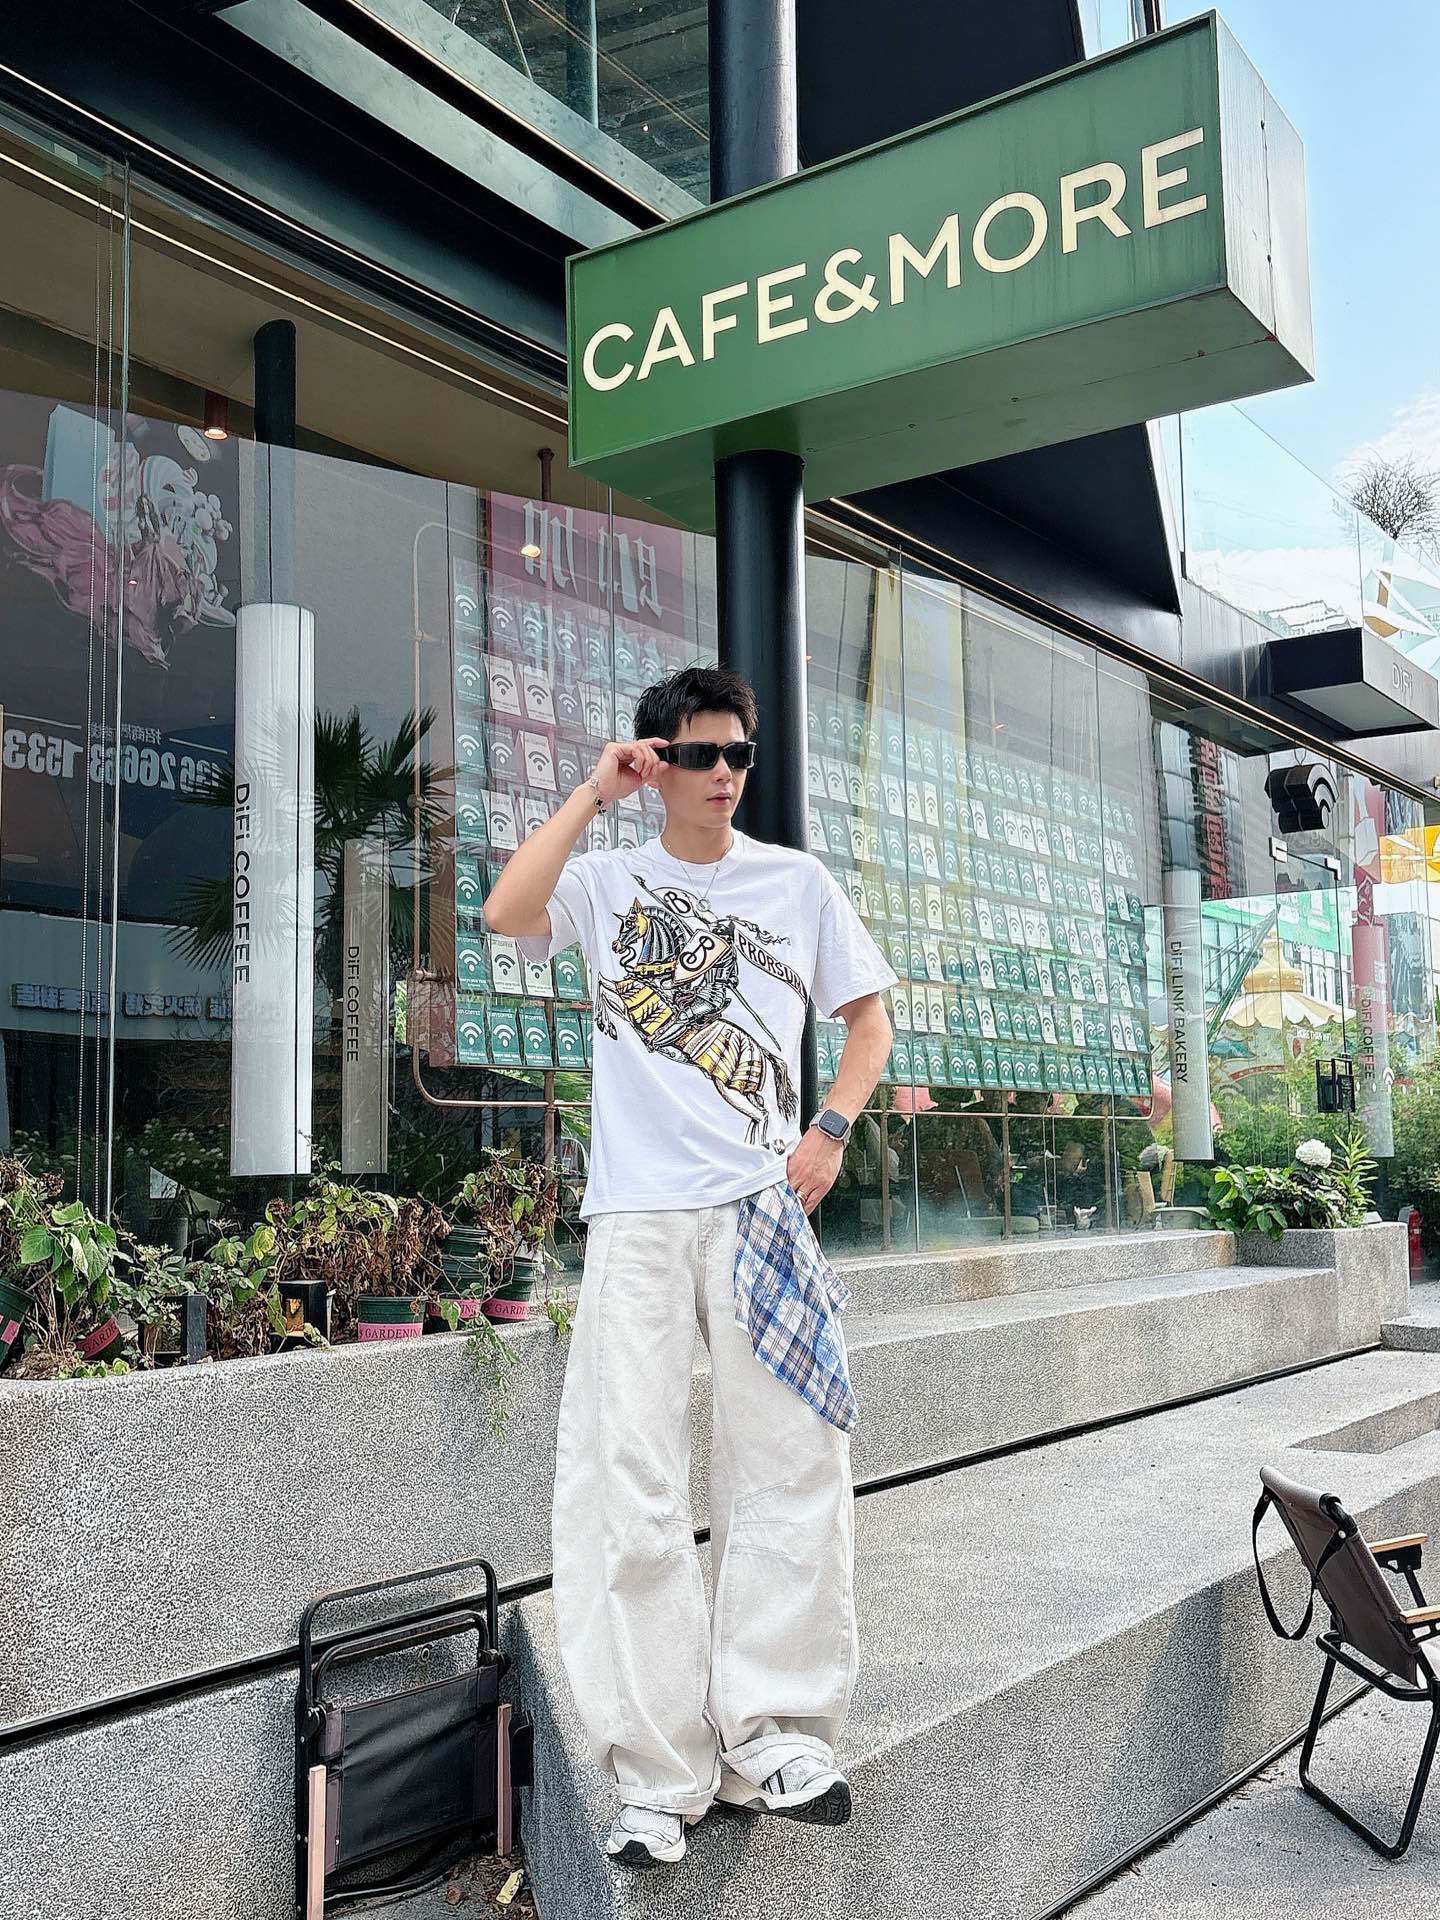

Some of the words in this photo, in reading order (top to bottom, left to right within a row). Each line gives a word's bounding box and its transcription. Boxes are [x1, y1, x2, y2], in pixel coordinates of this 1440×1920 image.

[582, 127, 1208, 392] CAFE&MORE
[235, 782, 250, 840] DiFi
[235, 850, 250, 985] COFFEE
[347, 946, 360, 979] DiFi
[1171, 974, 1185, 1013] LINK
[347, 985, 360, 1062] COFFEE
[1173, 1017, 1188, 1084] BAKERY
[1362, 1026, 1375, 1080] COFFEE
